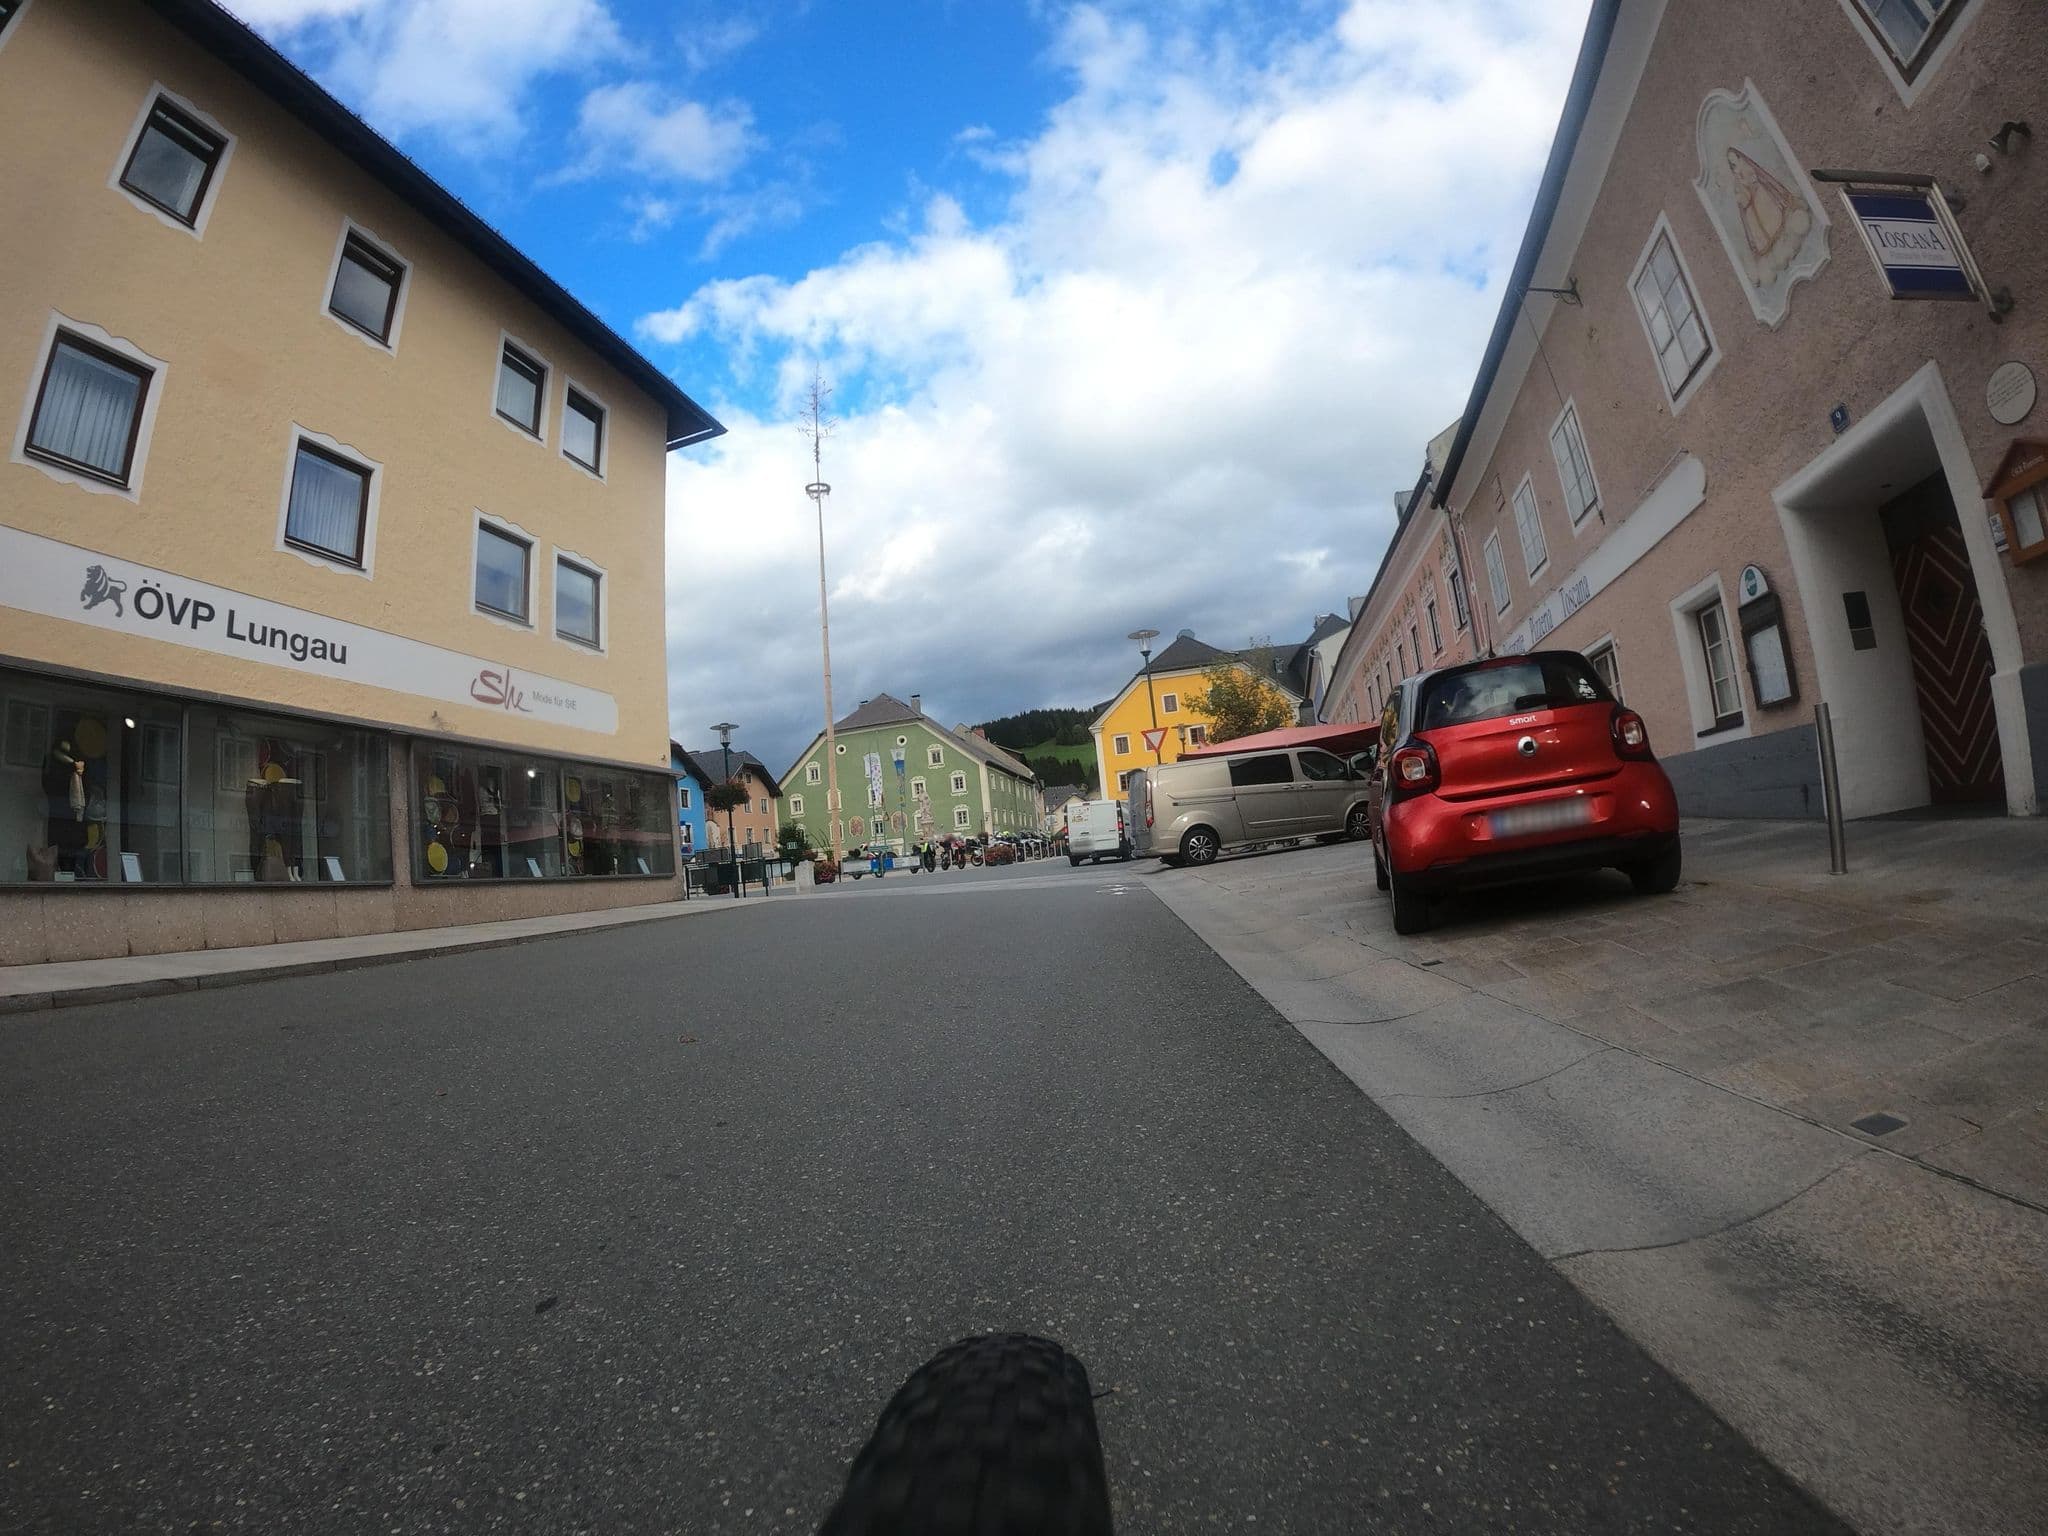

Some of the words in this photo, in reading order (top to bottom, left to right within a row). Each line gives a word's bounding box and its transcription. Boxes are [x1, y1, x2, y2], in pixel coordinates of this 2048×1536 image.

[1559, 575, 1591, 618] Toscana
[134, 579, 215, 630] ÖVP
[227, 609, 348, 665] Lungau
[471, 669, 533, 712] She
[532, 690, 552, 705] Mode
[1509, 715, 1537, 726] smart
